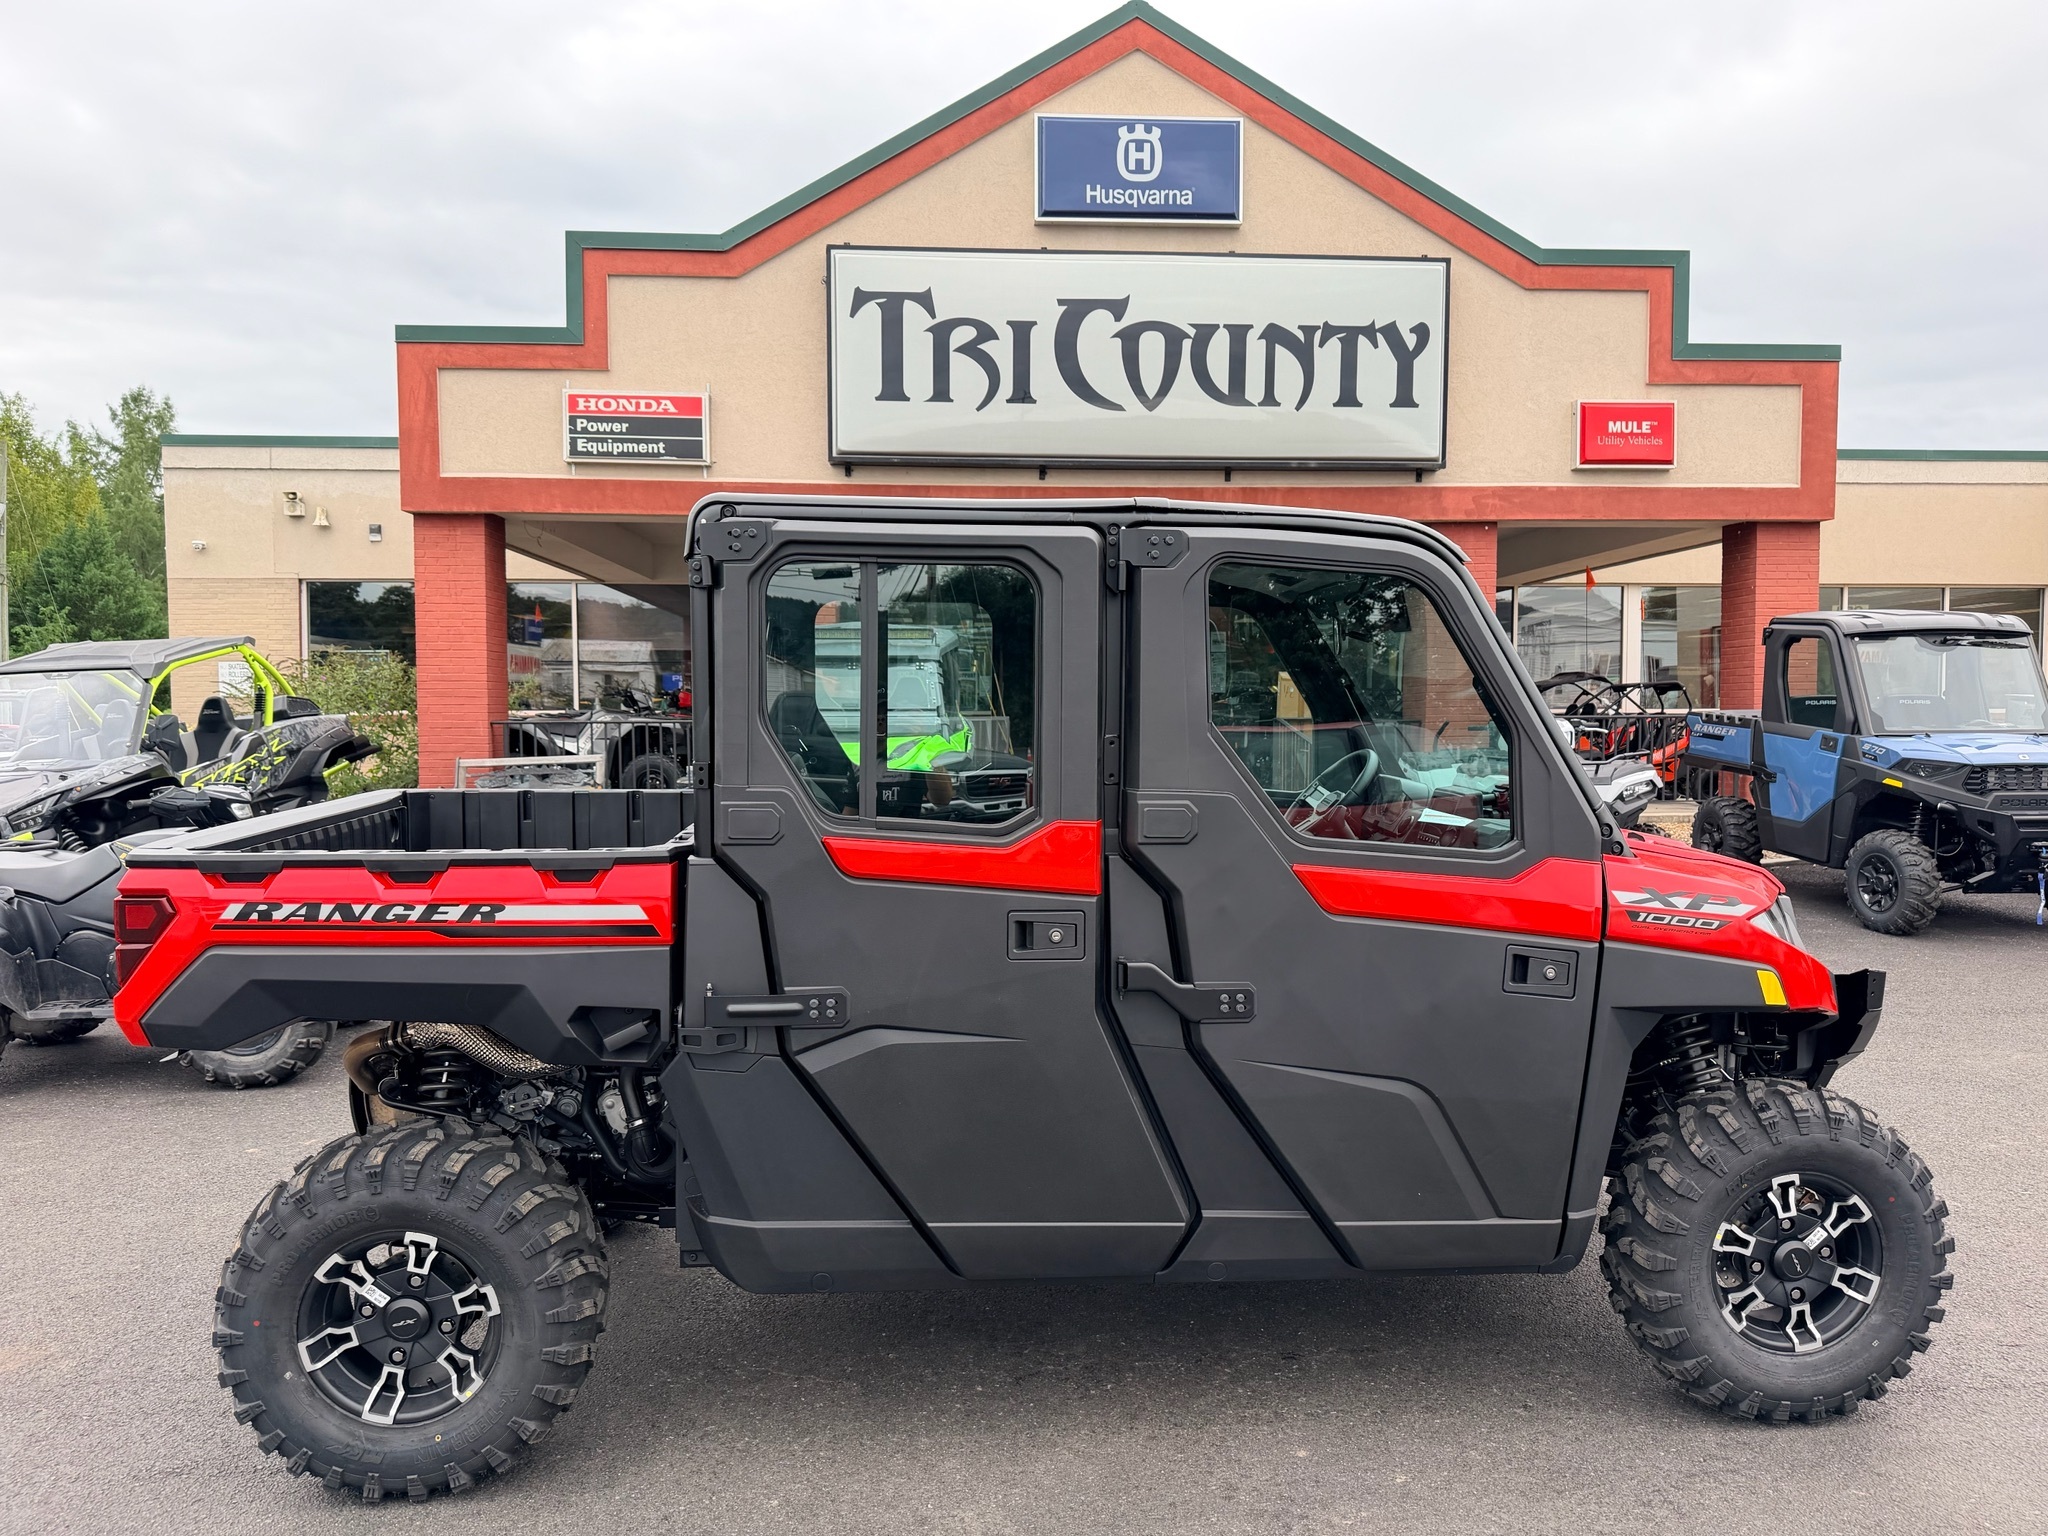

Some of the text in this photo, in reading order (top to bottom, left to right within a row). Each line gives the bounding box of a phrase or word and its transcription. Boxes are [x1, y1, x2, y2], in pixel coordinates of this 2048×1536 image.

[1086, 184, 1193, 208] Husqvarna
[576, 397, 678, 413] HONDA
[576, 418, 629, 432] Power
[576, 438, 666, 455] Equipment
[1597, 435, 1664, 447] Utility Vehicles
[1694, 723, 1737, 736] RANGER
[1624, 887, 1742, 911] XP
[232, 901, 507, 924] RANGER
[1636, 912, 1720, 930] 1000
